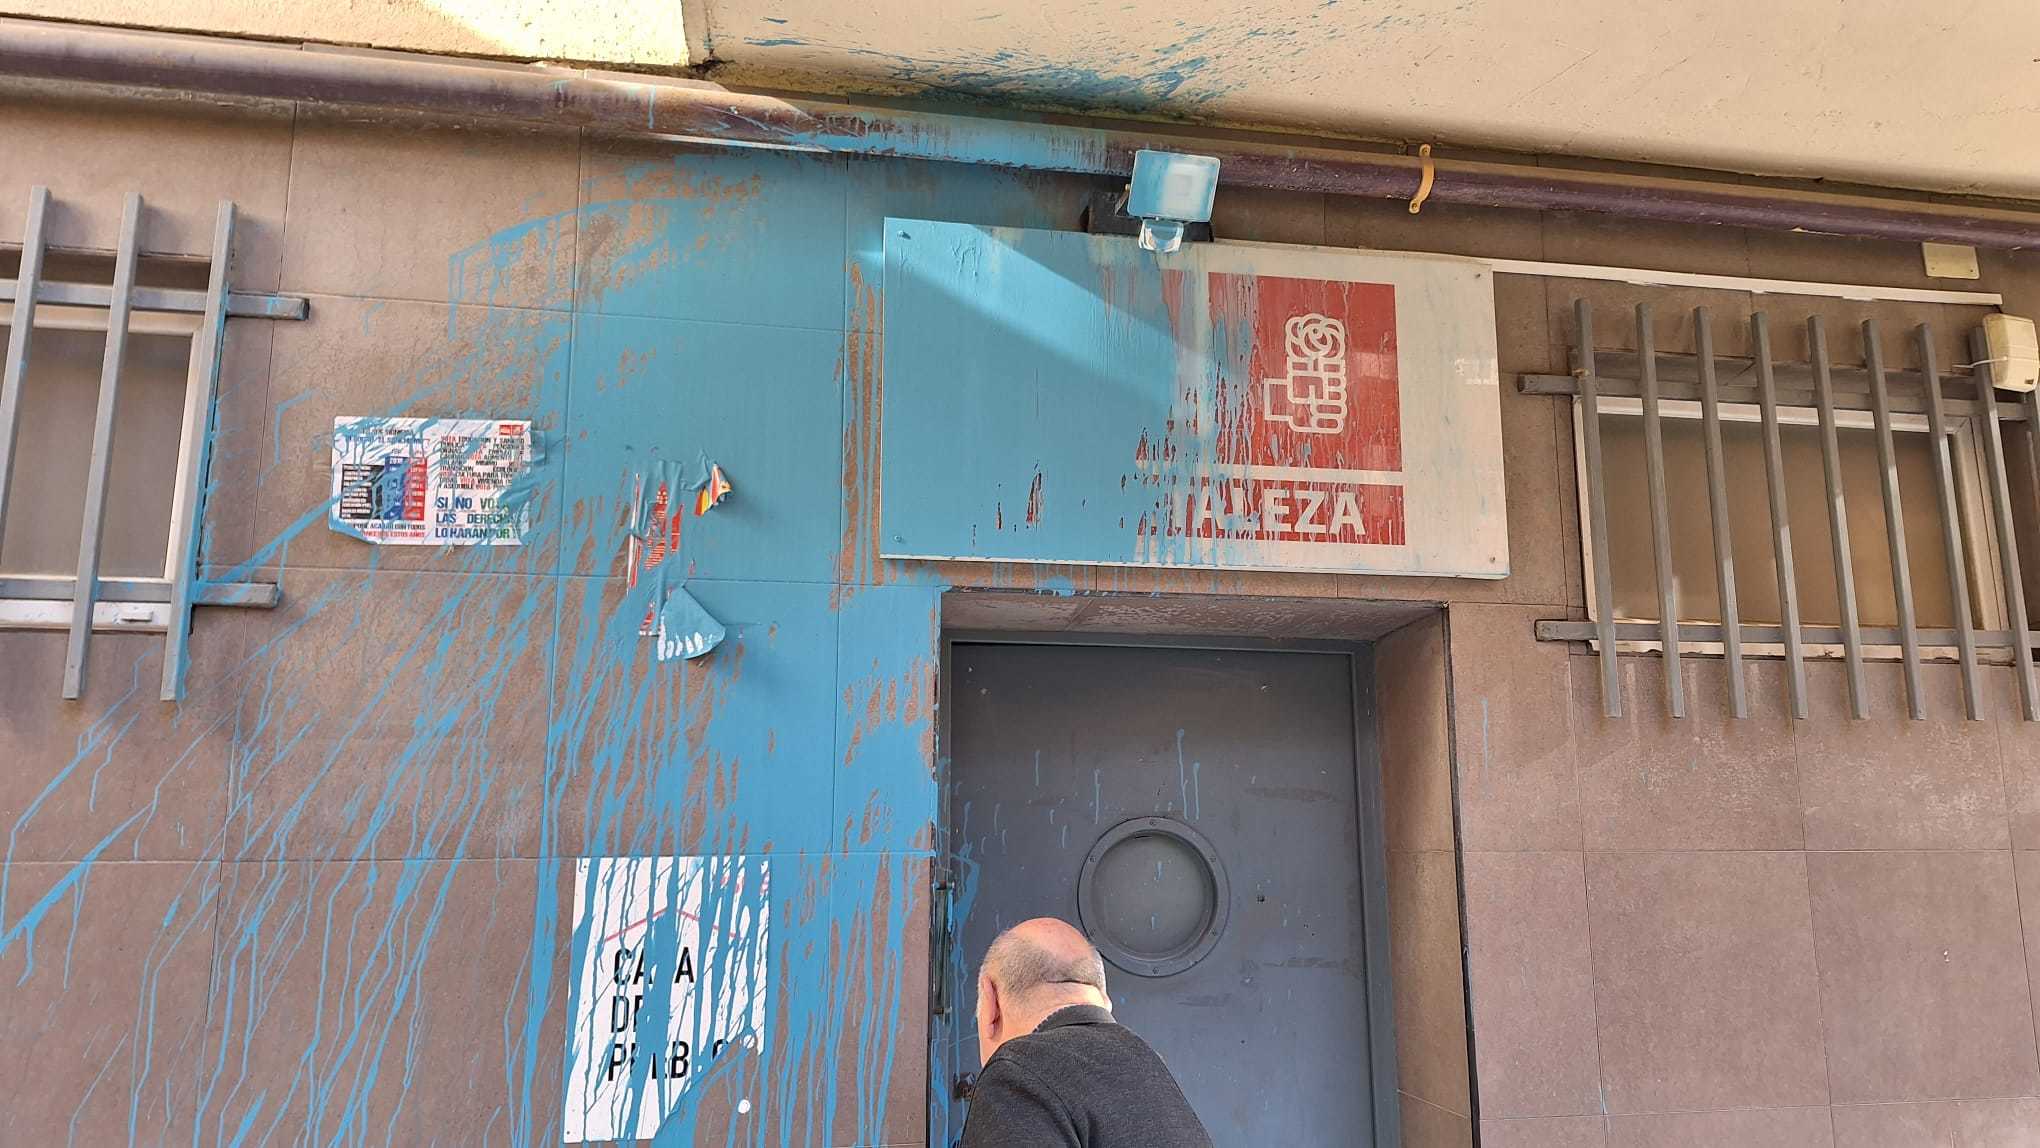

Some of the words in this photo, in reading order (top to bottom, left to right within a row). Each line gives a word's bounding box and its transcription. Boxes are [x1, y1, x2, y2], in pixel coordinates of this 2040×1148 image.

[437, 496, 449, 509] SI
[455, 496, 473, 510] NO
[436, 512, 457, 524] LAS
[434, 527, 448, 538] LO
[612, 946, 695, 985] CAA
